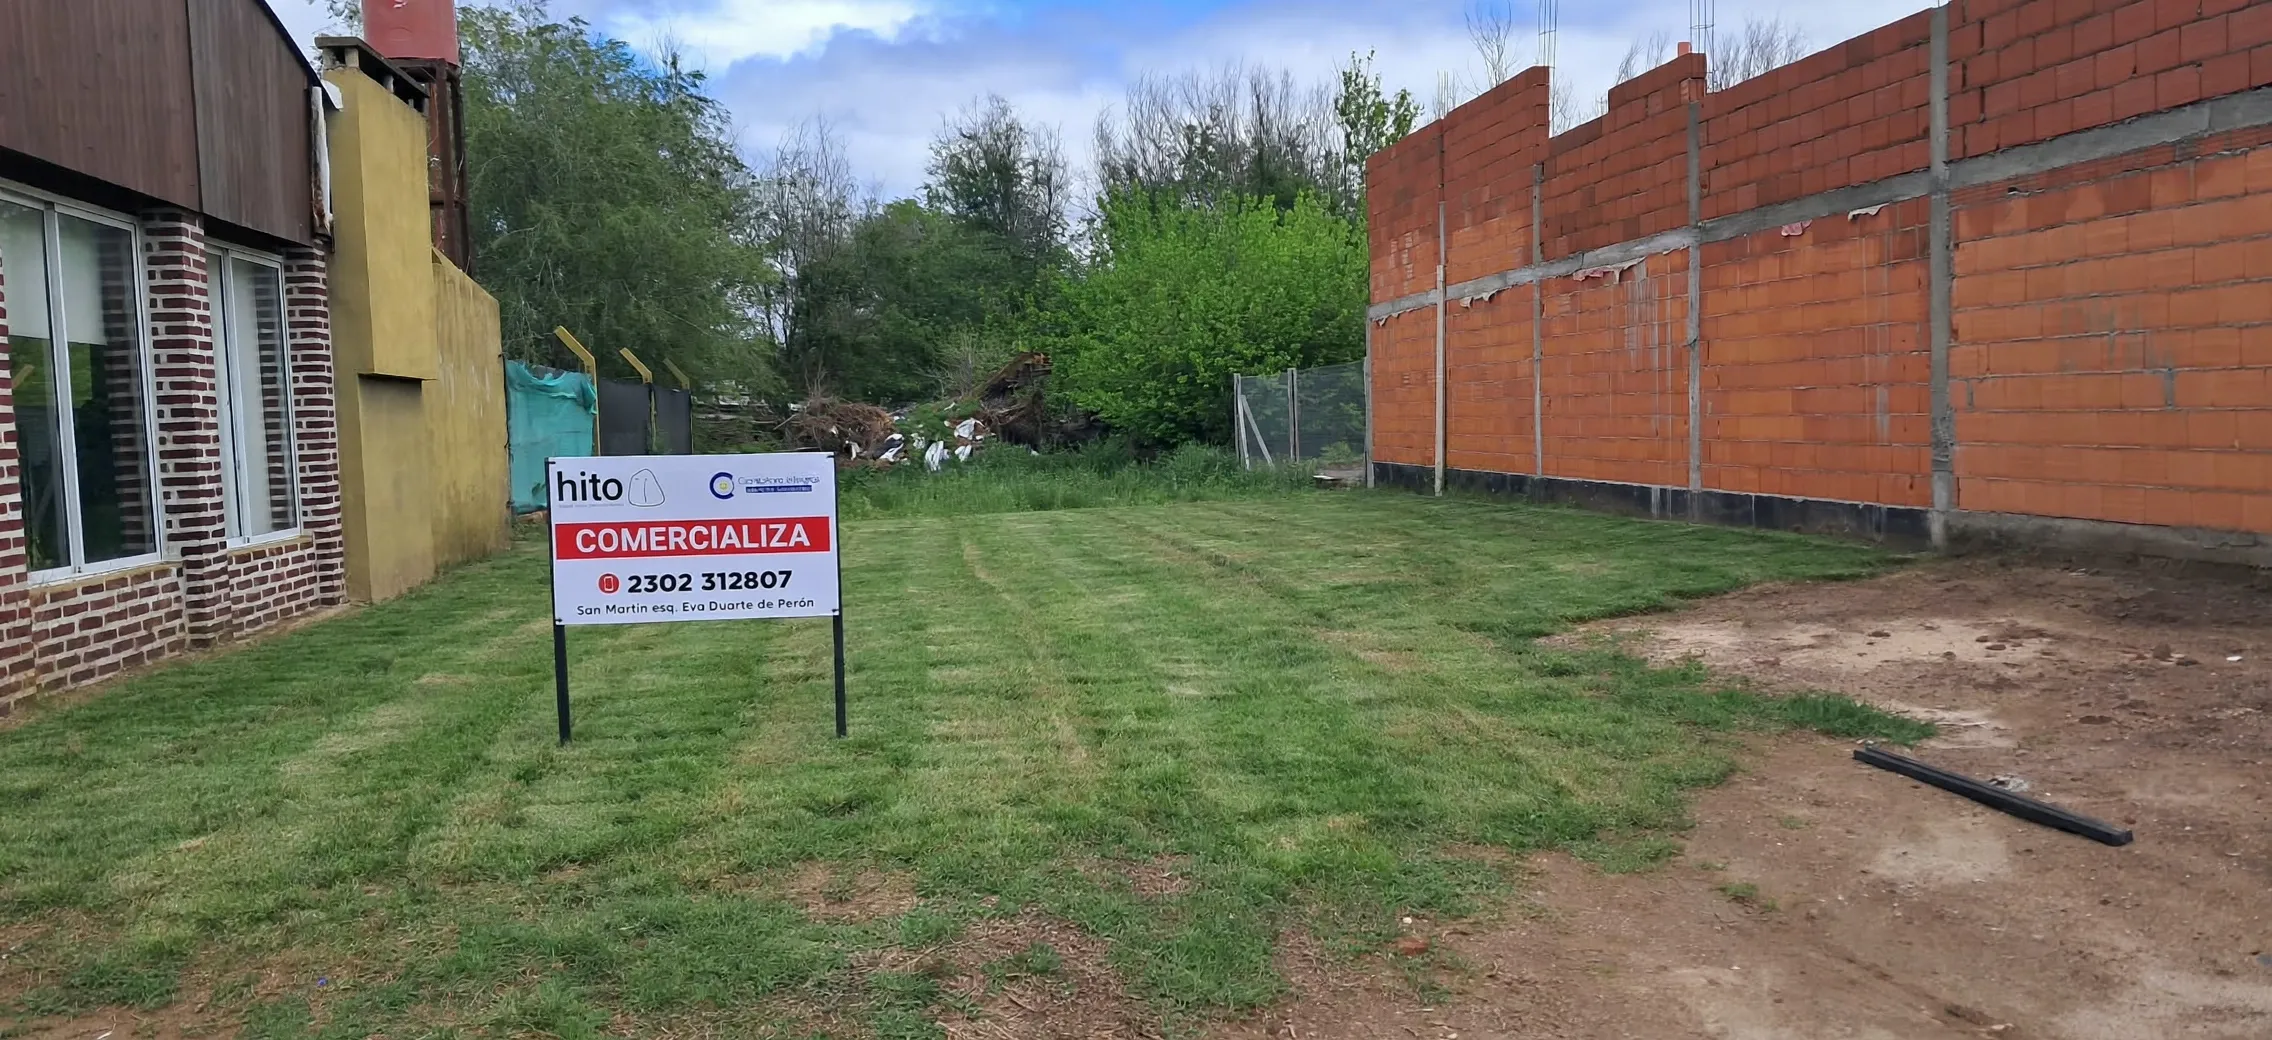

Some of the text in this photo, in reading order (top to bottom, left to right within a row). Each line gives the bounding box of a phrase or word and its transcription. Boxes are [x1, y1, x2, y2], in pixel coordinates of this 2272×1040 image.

[557, 470, 624, 502] hito
[575, 523, 811, 553] COMERCIALIZA
[627, 570, 793, 593] 2302 312807
[577, 605, 601, 615] San
[652, 603, 678, 614] esq.
[682, 601, 705, 612] Eva
[709, 600, 753, 611] Duarte
[757, 599, 774, 609] de
[778, 597, 815, 608] Perón
